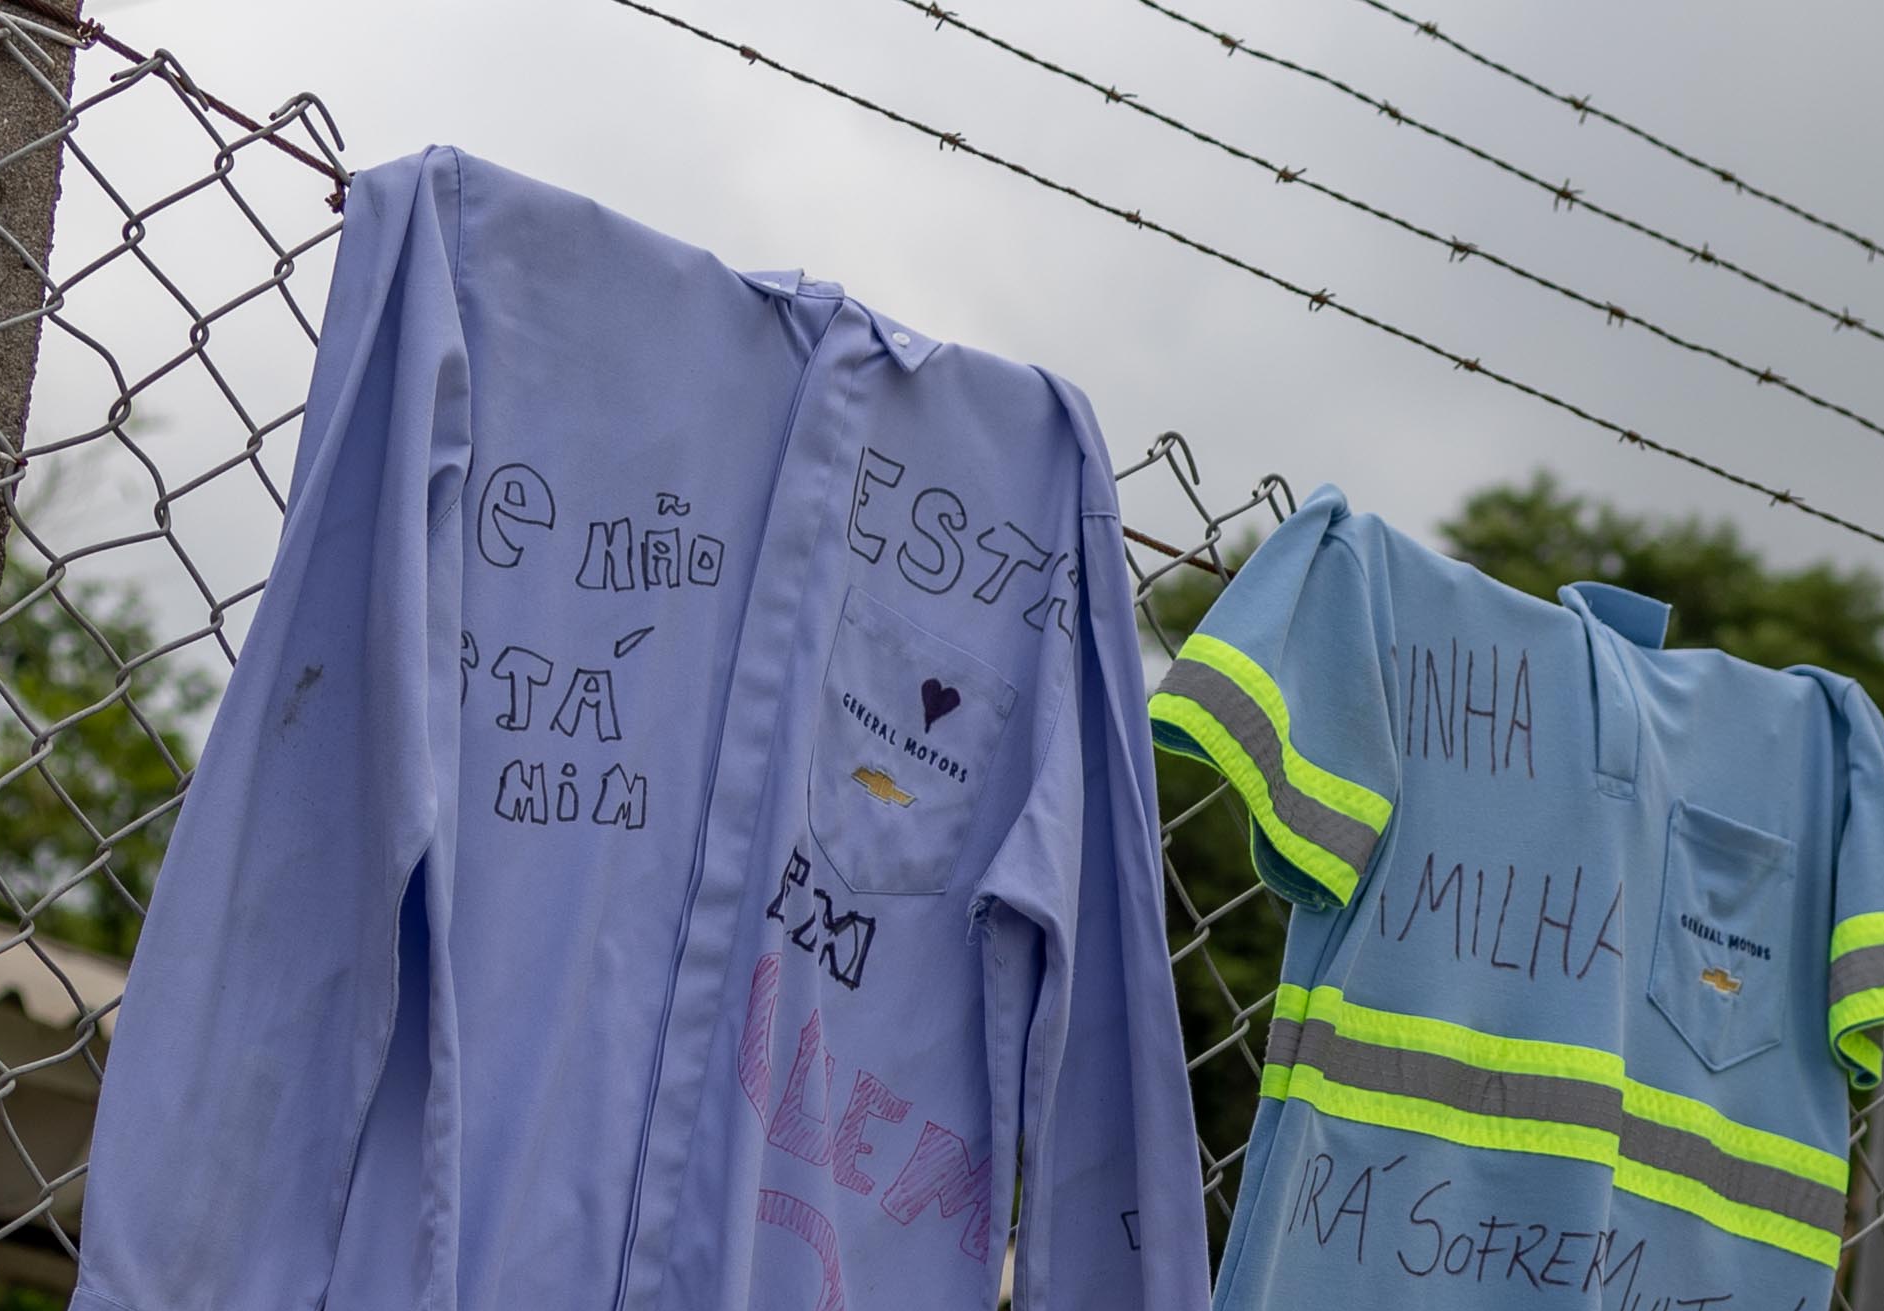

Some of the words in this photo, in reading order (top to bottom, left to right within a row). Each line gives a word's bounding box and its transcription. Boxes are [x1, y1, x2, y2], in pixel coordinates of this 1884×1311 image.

[841, 692, 897, 747] GENERAL
[903, 736, 969, 785] MOTORS
[1680, 913, 1724, 946] GENERAL
[1728, 933, 1772, 961] MOTORS
